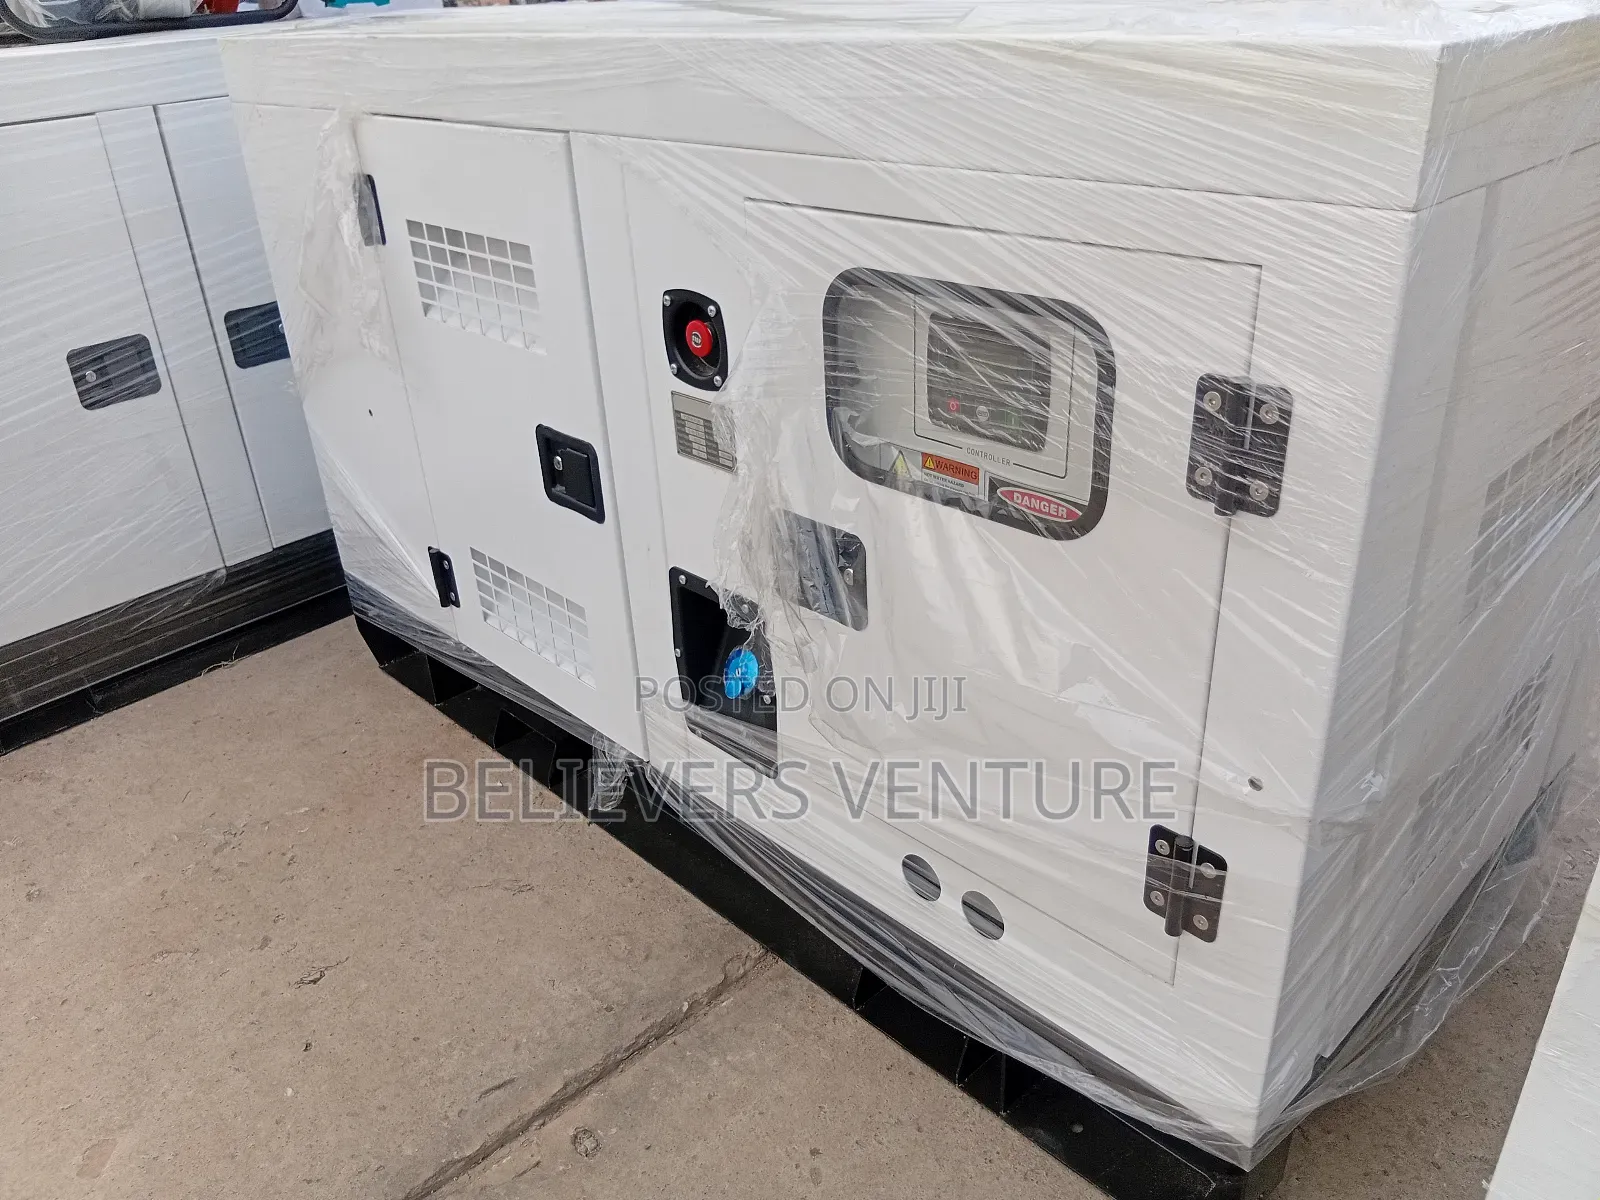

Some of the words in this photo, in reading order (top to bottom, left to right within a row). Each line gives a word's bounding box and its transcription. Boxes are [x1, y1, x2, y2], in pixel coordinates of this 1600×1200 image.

[966, 447, 1011, 466] CONTROLLER
[935, 460, 978, 480] WARNING
[1013, 491, 1068, 519] DANGER
